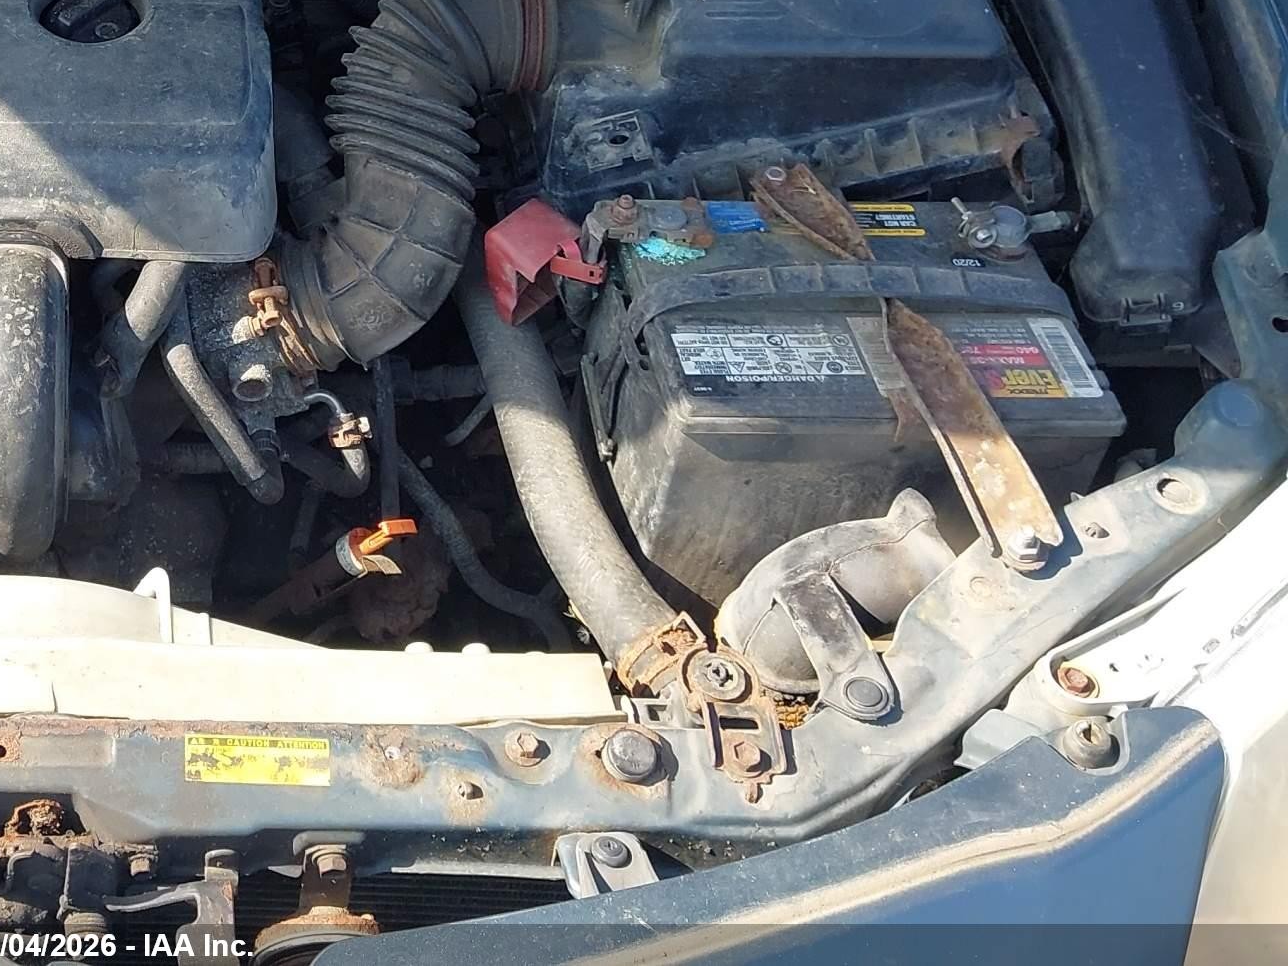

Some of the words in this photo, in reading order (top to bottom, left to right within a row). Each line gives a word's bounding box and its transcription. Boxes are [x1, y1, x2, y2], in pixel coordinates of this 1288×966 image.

[952, 258, 981, 267] 12/20
[726, 374, 815, 383] DANGER/POISON
[226, 738, 271, 748] CAUTION
[277, 740, 327, 751] ATTENTION
